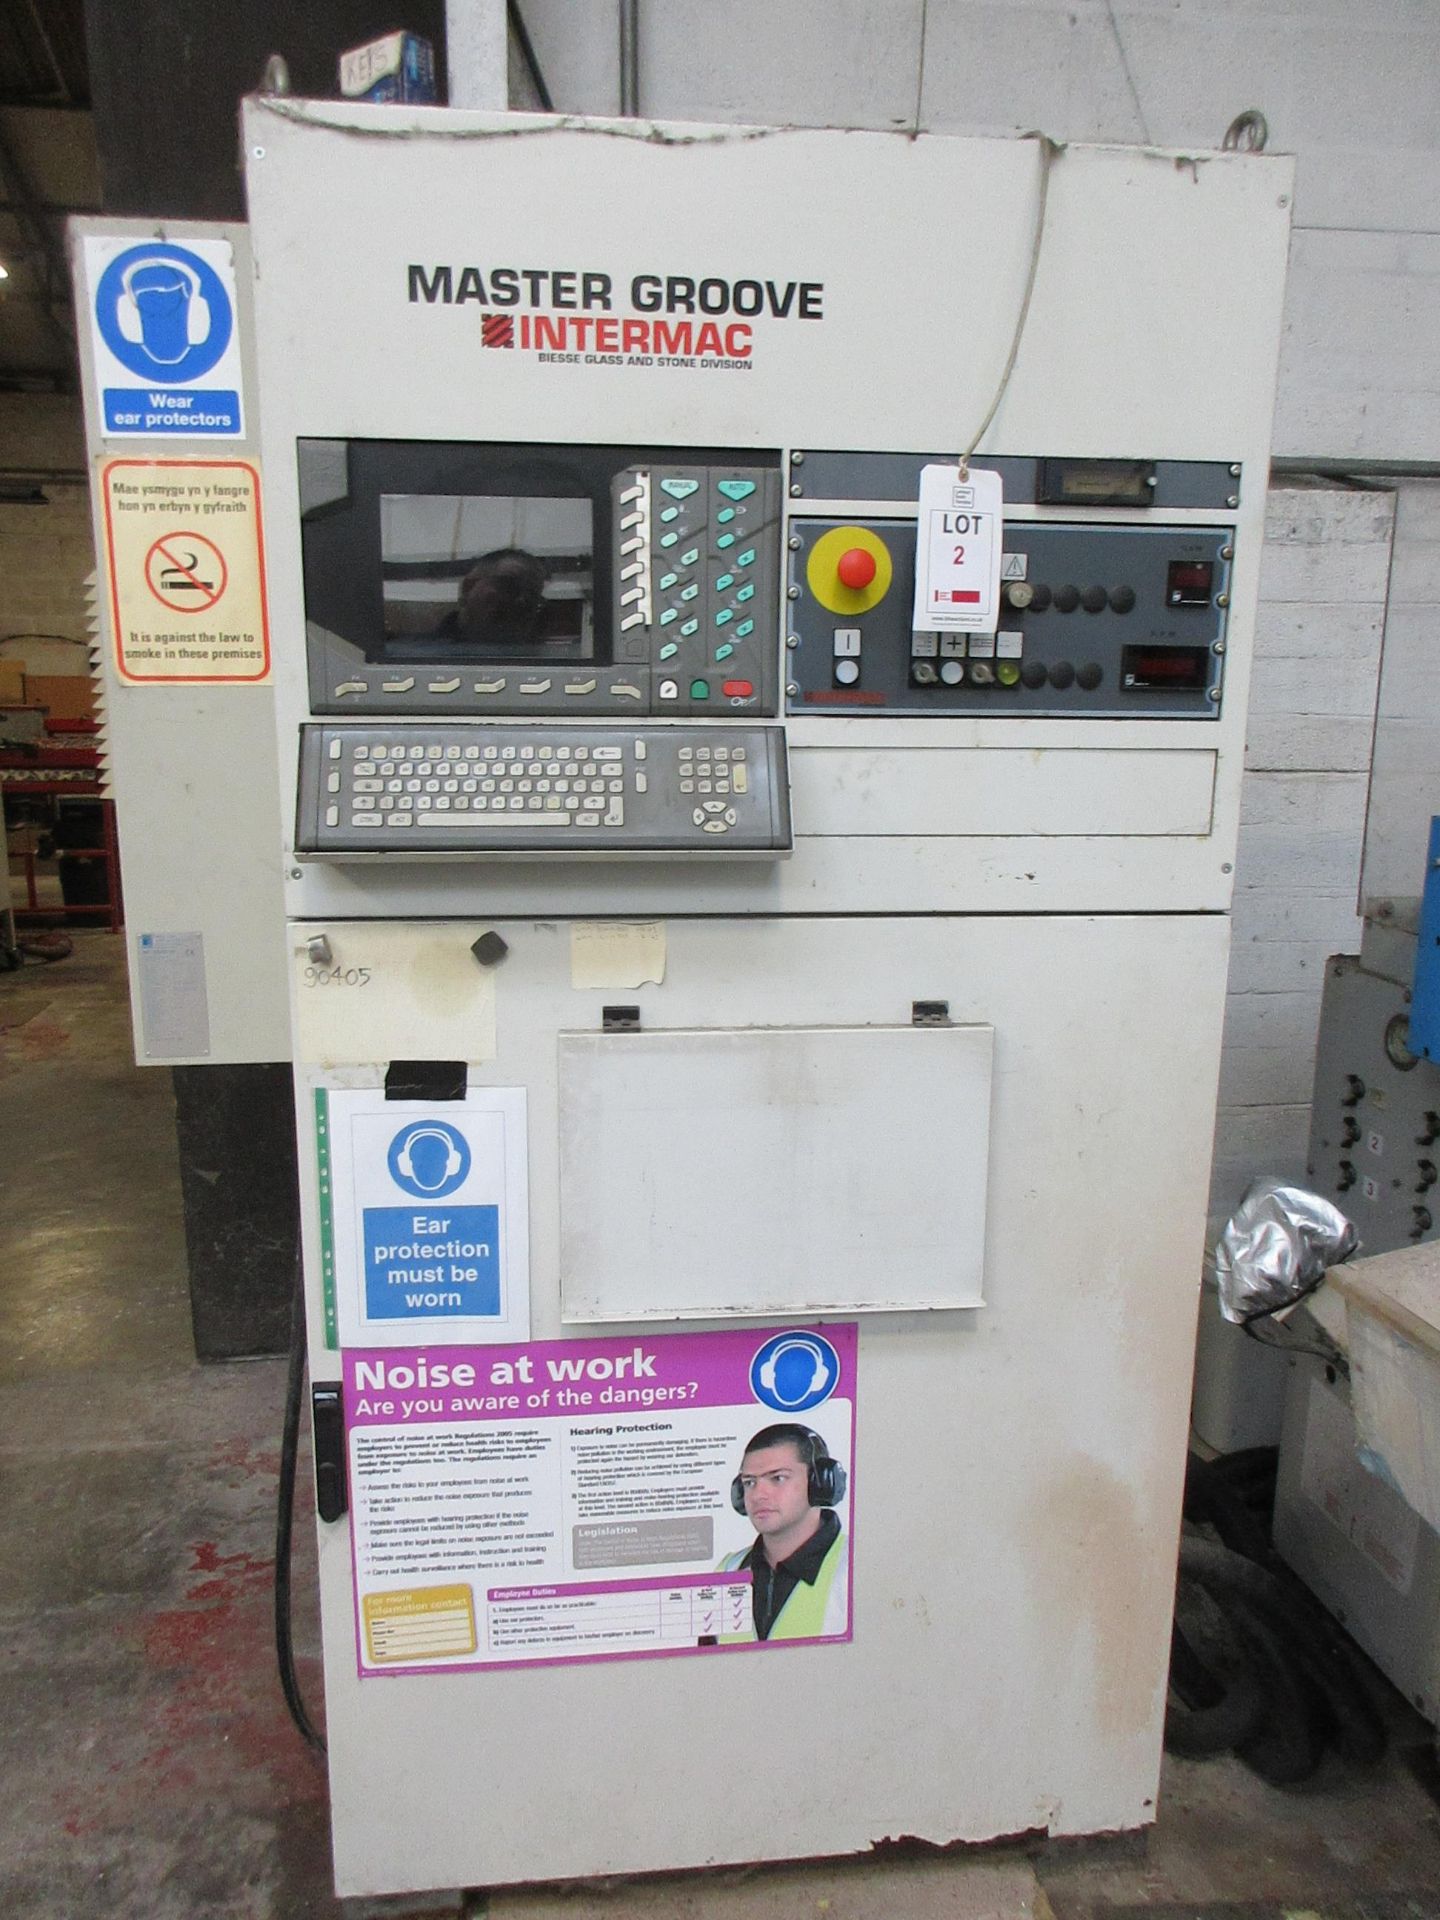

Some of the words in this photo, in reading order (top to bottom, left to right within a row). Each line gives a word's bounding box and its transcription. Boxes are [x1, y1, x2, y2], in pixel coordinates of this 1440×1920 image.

[408, 265, 612, 310] MASTER
[631, 275, 823, 320] GROOVE
[521, 315, 752, 357] INTERMAC
[538, 353, 580, 364] BIESSE
[585, 355, 623, 365] GLASS
[628, 356, 653, 367] AND
[658, 357, 696, 368] STONE
[701, 359, 752, 370] DIVISION
[149, 393, 193, 407] Wear
[114, 414, 141, 424] ear
[146, 413, 231, 427] protectors
[113, 484, 139, 494] Mae
[142, 486, 184, 496] ysmygu
[188, 487, 201, 495] yn
[205, 487, 210, 497] y
[214, 486, 249, 498] fangre
[118, 501, 139, 510] hon
[143, 503, 155, 512] yn
[159, 501, 190, 514] erbyn
[195, 503, 199, 514] y
[203, 502, 246, 514] gyfraith
[943, 514, 982, 534] LOT
[953, 546, 964, 565] 2
[131, 632, 138, 642] It
[142, 632, 150, 641] is
[155, 633, 196, 644] against
[199, 633, 215, 642] the
[220, 633, 240, 642] law
[244, 634, 254, 642] to
[125, 649, 161, 659] smoke
[165, 650, 176, 659] in
[179, 649, 208, 659] these
[212, 649, 262, 660] premises
[303, 966, 371, 987] 90405
[413, 1216, 451, 1234] Ear
[375, 1240, 489, 1263] protection
[388, 1265, 444, 1283] must
[451, 1266, 478, 1282] be
[405, 1292, 461, 1308] worn
[355, 1358, 476, 1390] Noise
[491, 1356, 533, 1384] at
[547, 1348, 657, 1381] work
[356, 1399, 394, 1416] Are
[402, 1399, 443, 1418] you
[451, 1395, 520, 1411] aware
[527, 1389, 550, 1407] of
[556, 1388, 592, 1406] the
[600, 1382, 698, 1405] dangers?
[570, 1427, 613, 1436] Hearing
[616, 1423, 673, 1433] Protection
[578, 1526, 638, 1537] Legislation
[494, 1590, 530, 1598] Employee
[533, 1588, 556, 1596] Duties
[369, 1603, 428, 1616] information
[431, 1599, 466, 1608] contact
